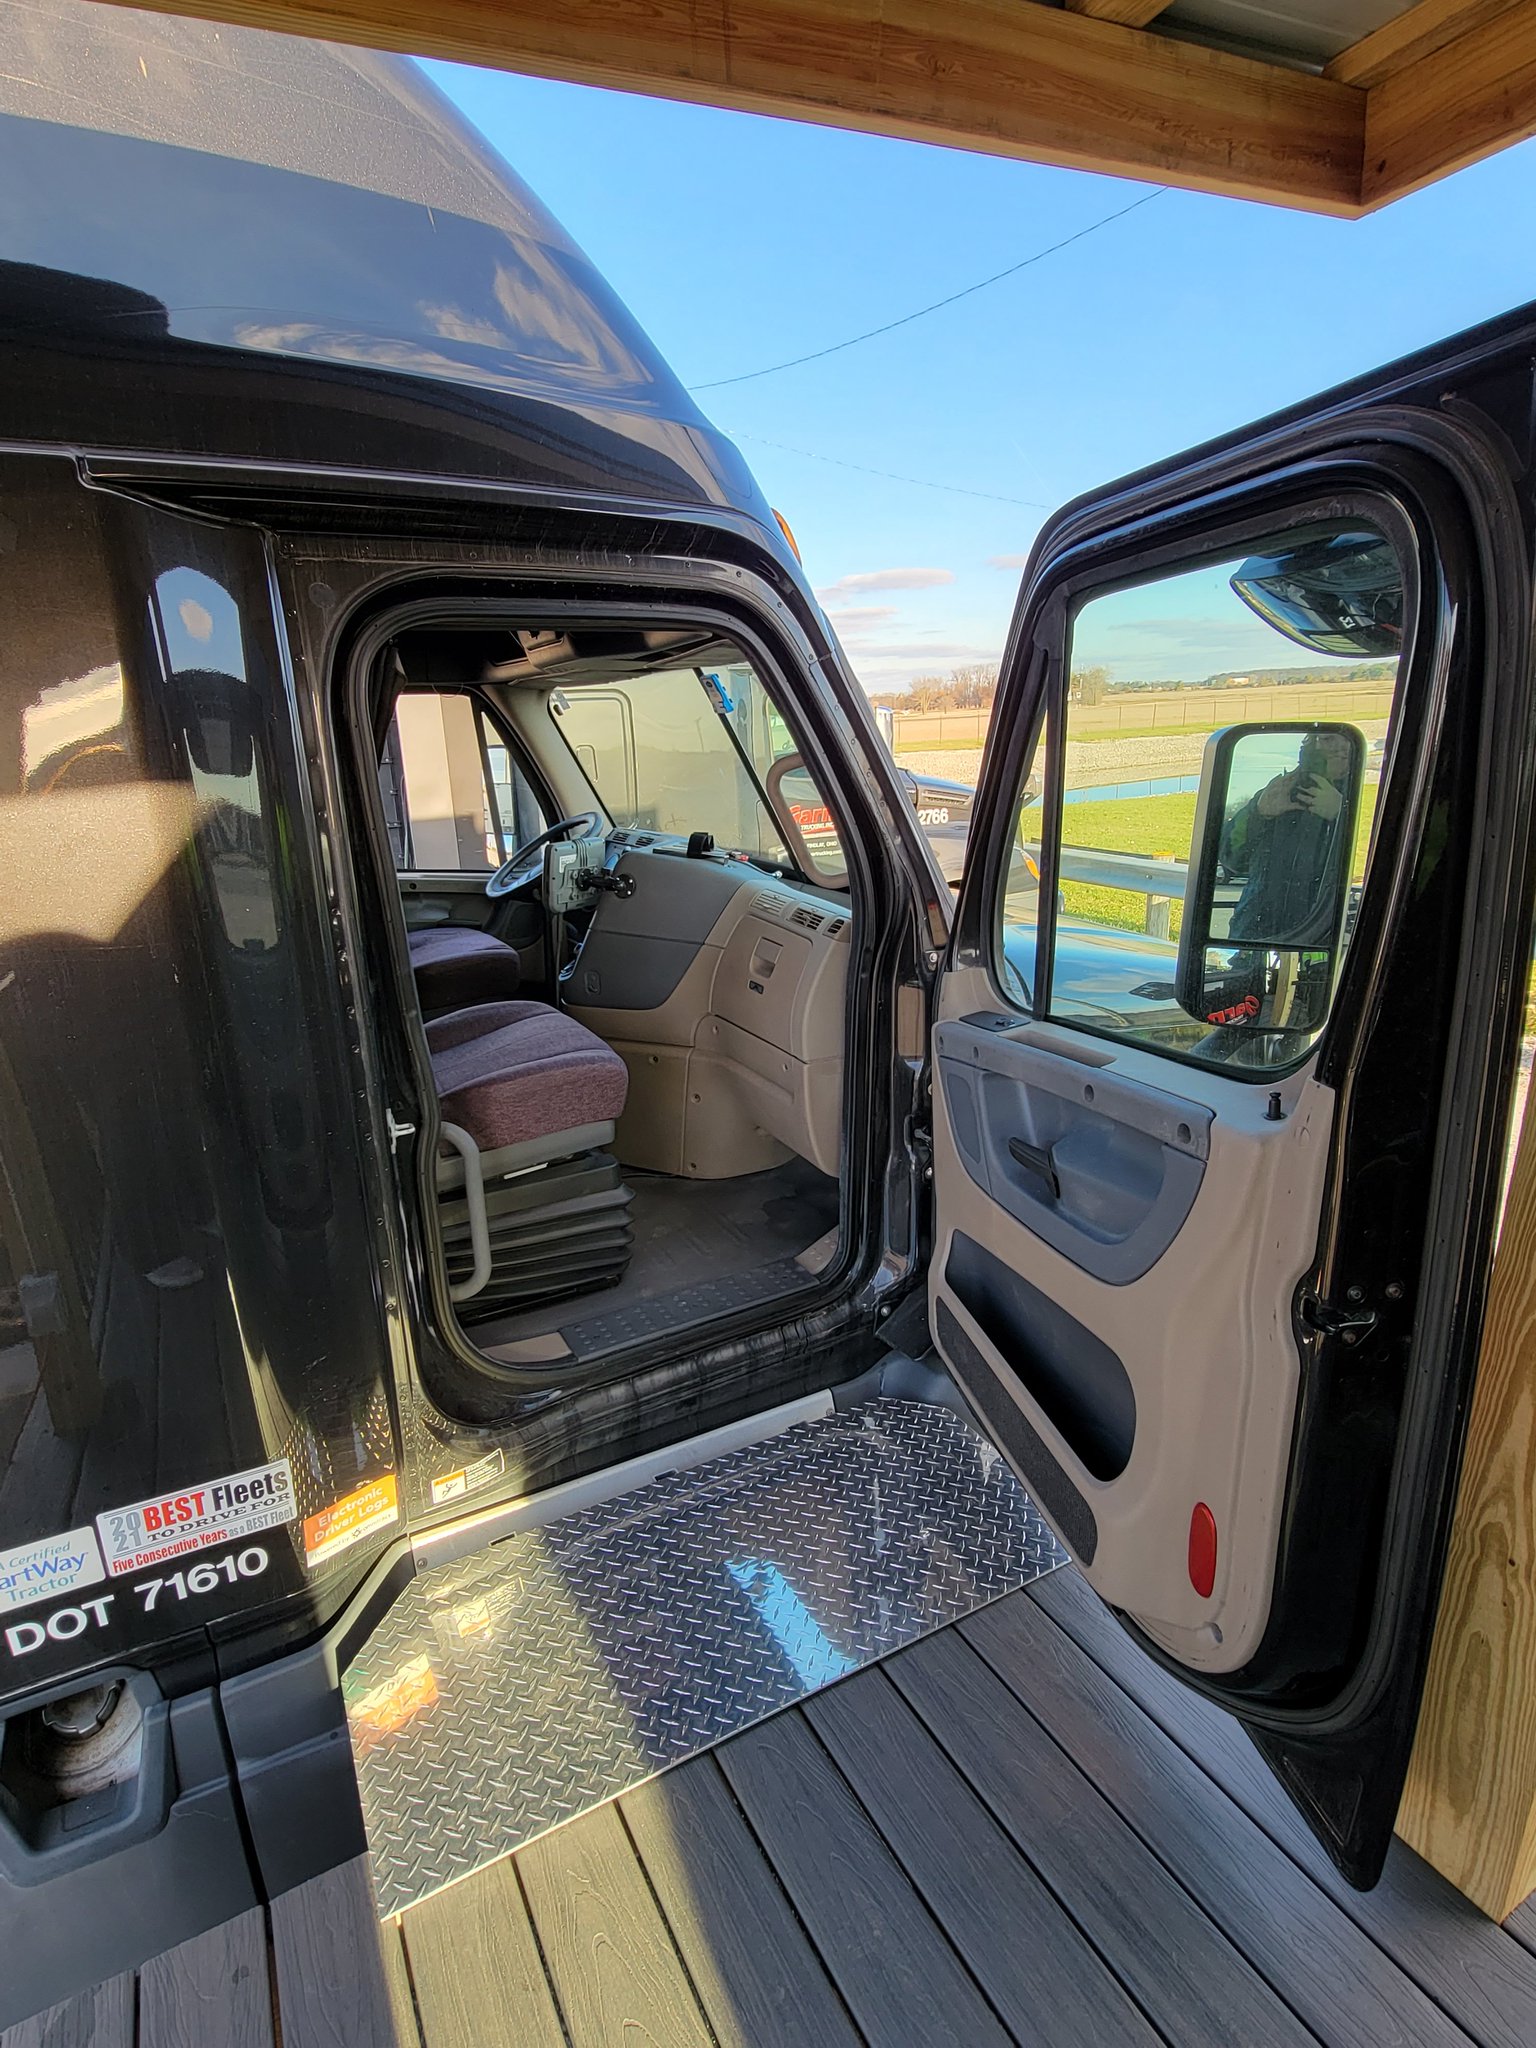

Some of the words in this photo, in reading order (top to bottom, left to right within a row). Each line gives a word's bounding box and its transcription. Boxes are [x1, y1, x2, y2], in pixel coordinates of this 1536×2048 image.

[918, 808, 949, 826] 2766
[142, 1491, 205, 1532] BEST
[211, 1471, 288, 1511] Fleets
[147, 1527, 175, 1542] TO
[180, 1505, 246, 1534] DRIVE
[250, 1492, 291, 1511] FOR
[314, 1513, 356, 1542] Driver
[358, 1496, 389, 1518] Logs
[318, 1487, 383, 1528] Electronic
[9, 1541, 71, 1568] Certified
[112, 1556, 134, 1574] Five
[135, 1536, 199, 1566] Consecutive
[199, 1529, 228, 1546] Years
[228, 1528, 239, 1538] as
[246, 1515, 269, 1531] BEST
[270, 1506, 294, 1525] Fleet
[4, 1594, 115, 1657] DOT
[134, 1547, 269, 1612] 71610
[5, 1573, 78, 1602] Tractor
